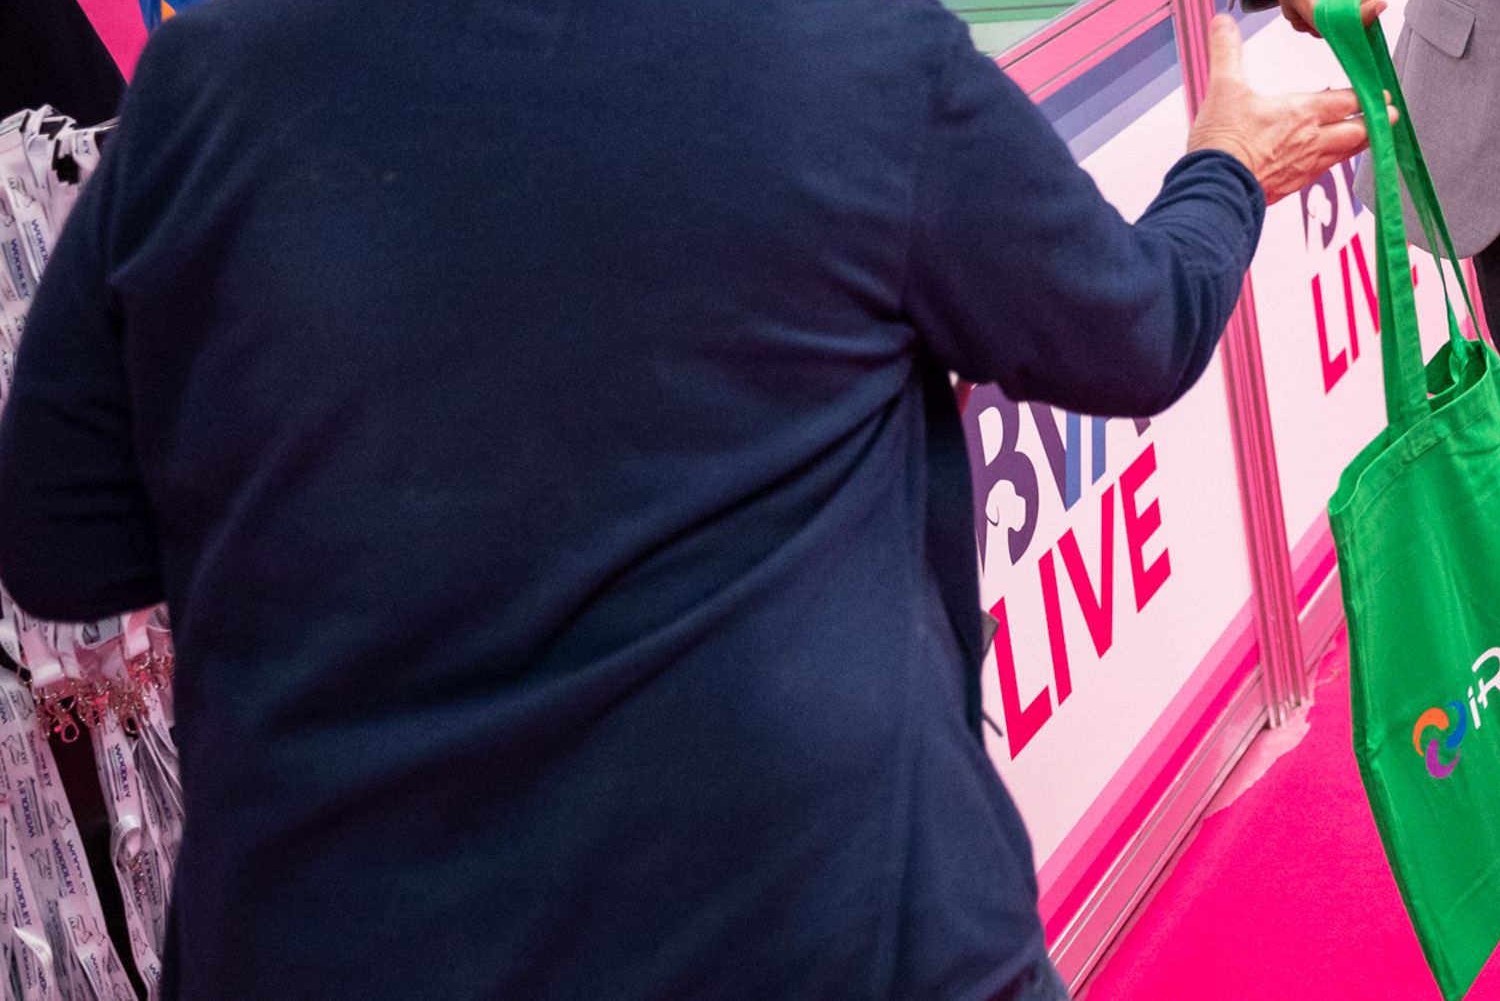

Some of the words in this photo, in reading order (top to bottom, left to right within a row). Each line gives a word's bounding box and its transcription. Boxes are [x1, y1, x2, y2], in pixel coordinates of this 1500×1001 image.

[10, 238, 31, 299] WOODLEY
[988, 441, 1172, 762] LIVE
[115, 742, 131, 798] WOODLEY
[17, 778, 36, 839] WOODLEY
[52, 837, 76, 895] WOODLEY
